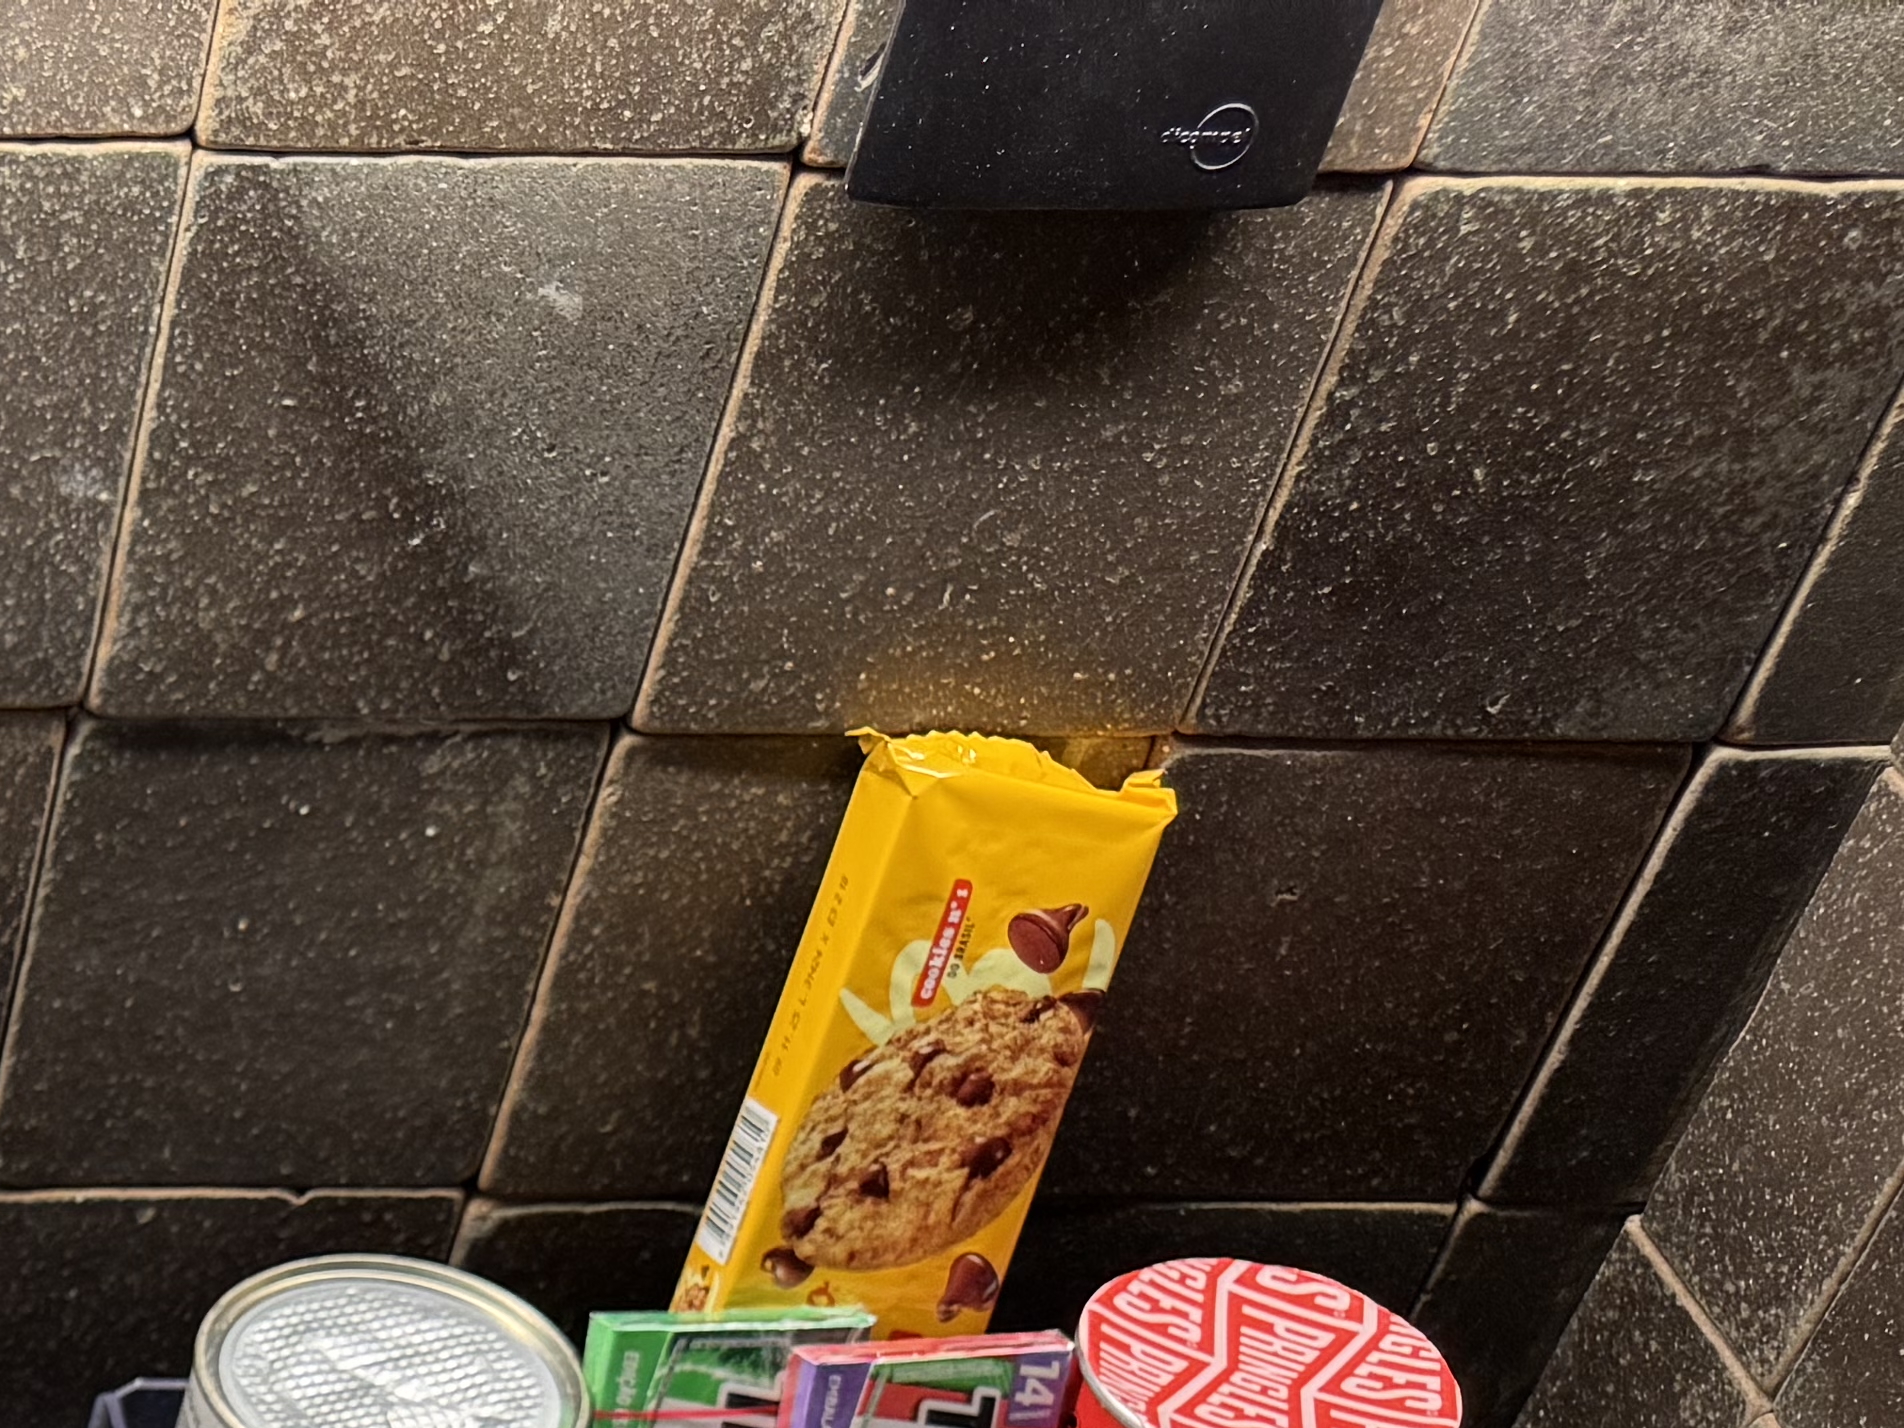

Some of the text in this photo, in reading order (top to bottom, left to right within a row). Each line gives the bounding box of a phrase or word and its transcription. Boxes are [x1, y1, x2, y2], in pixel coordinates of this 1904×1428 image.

[919, 926, 956, 1000] cookies
[947, 963, 961, 979] DO
[1015, 1363, 1061, 1407] 14
